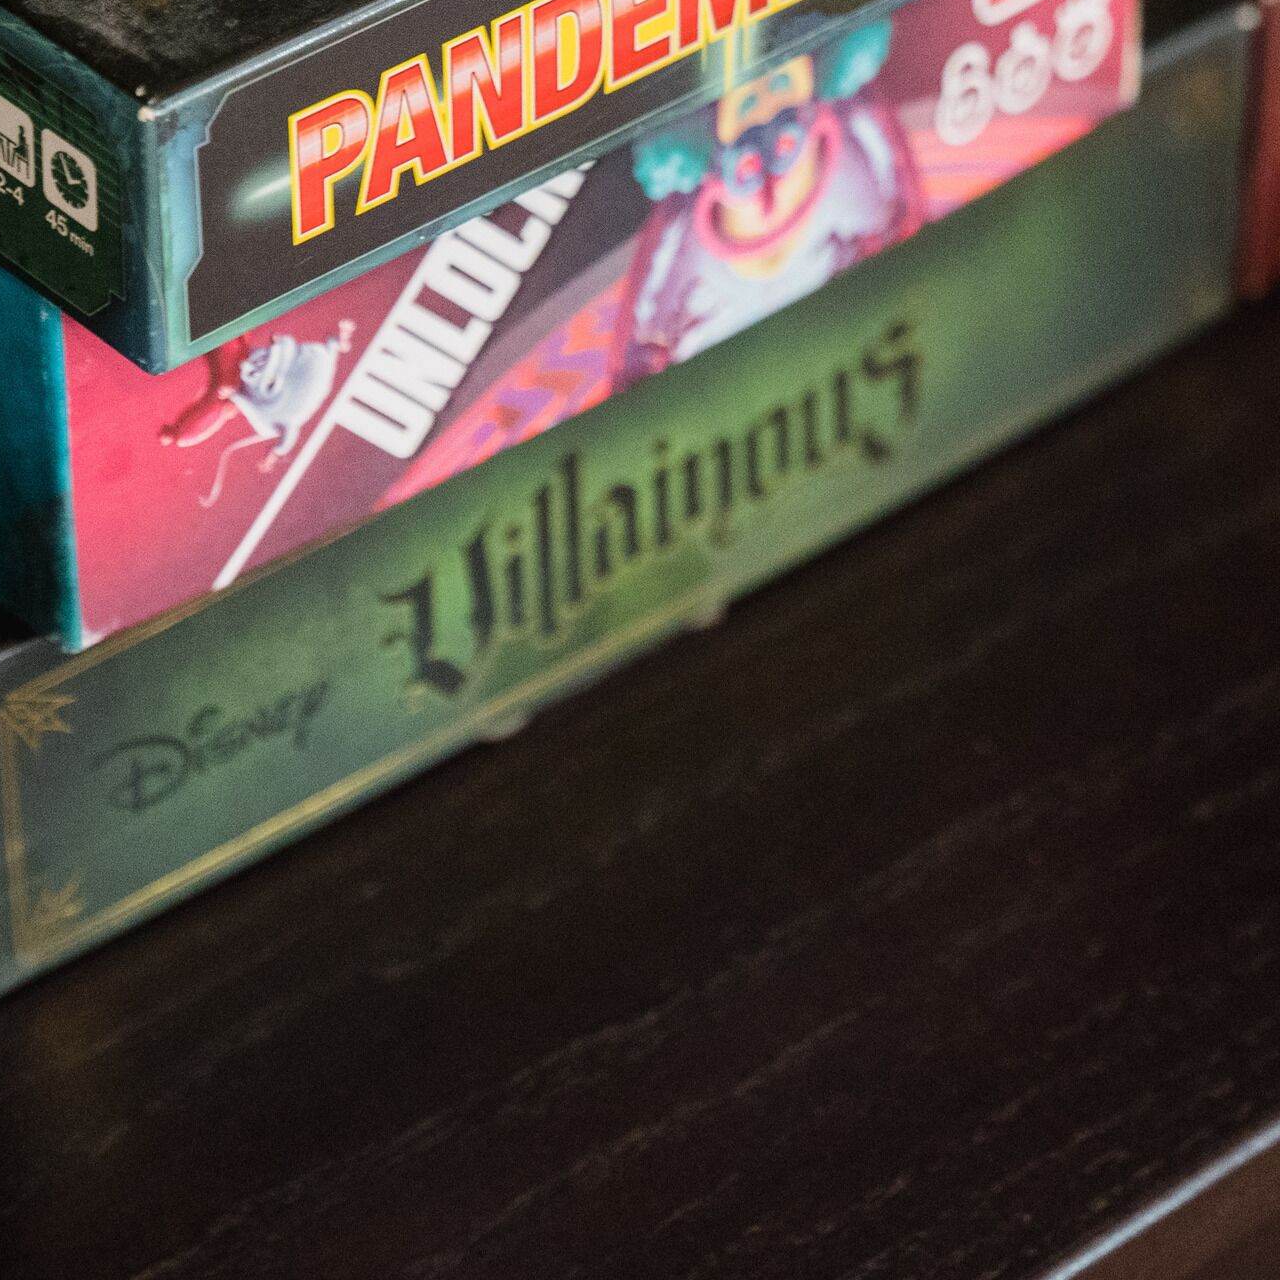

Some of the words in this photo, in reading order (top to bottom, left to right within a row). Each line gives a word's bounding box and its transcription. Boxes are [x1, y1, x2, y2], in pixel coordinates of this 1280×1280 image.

[43, 208, 70, 239] 45
[68, 228, 96, 258] min
[376, 318, 922, 710] Villainous
